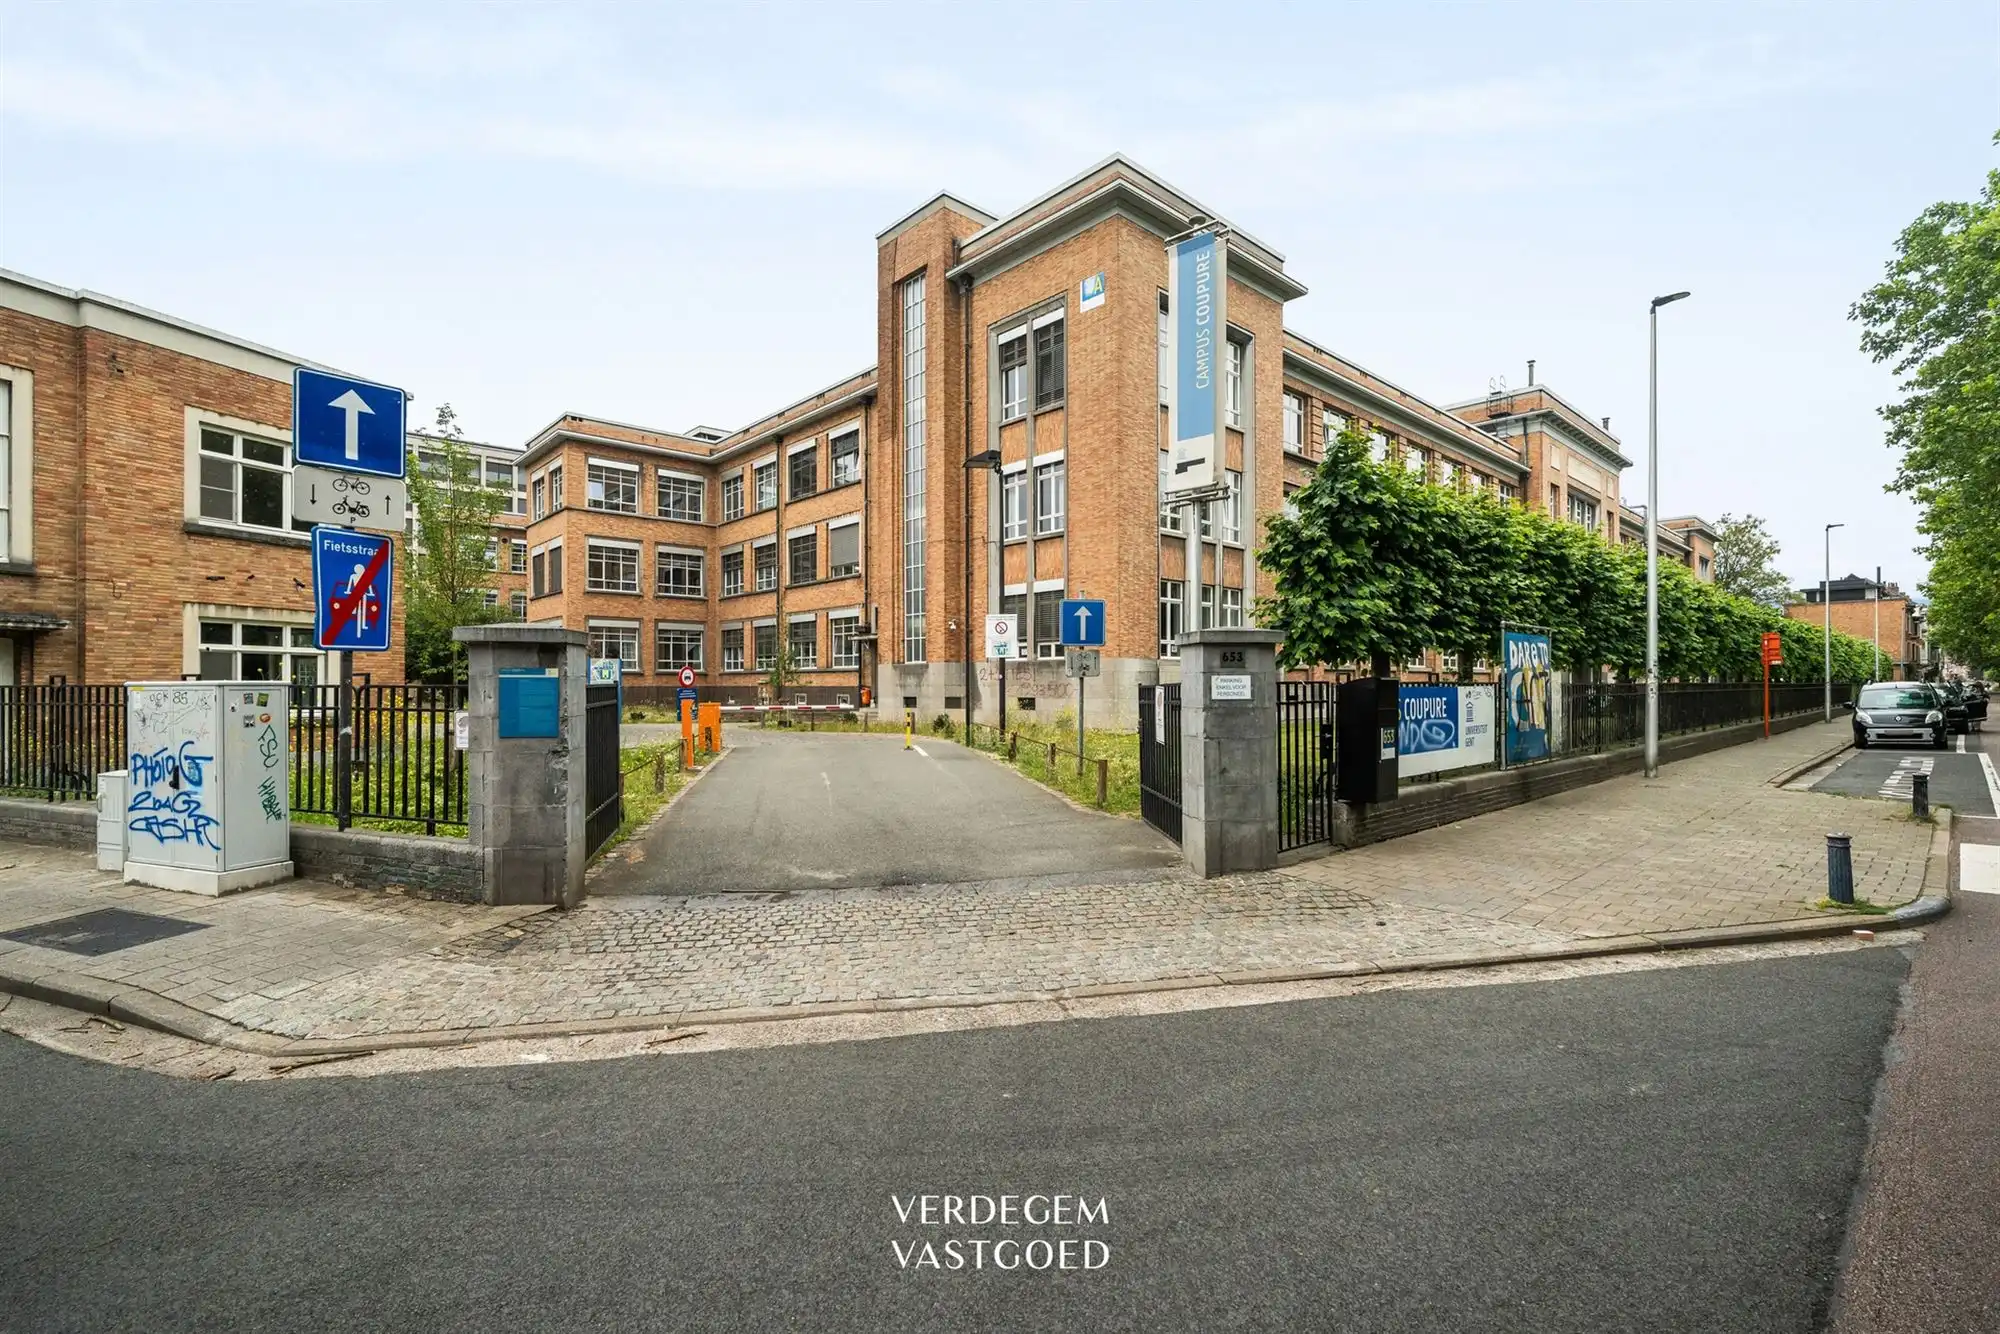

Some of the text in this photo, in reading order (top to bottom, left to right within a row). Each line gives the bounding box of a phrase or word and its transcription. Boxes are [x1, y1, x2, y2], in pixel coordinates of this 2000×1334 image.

[1195, 249, 1210, 390] CAMPUS COUPURE
[1222, 651, 1243, 662] 653
[1404, 697, 1447, 720] COUPURE
